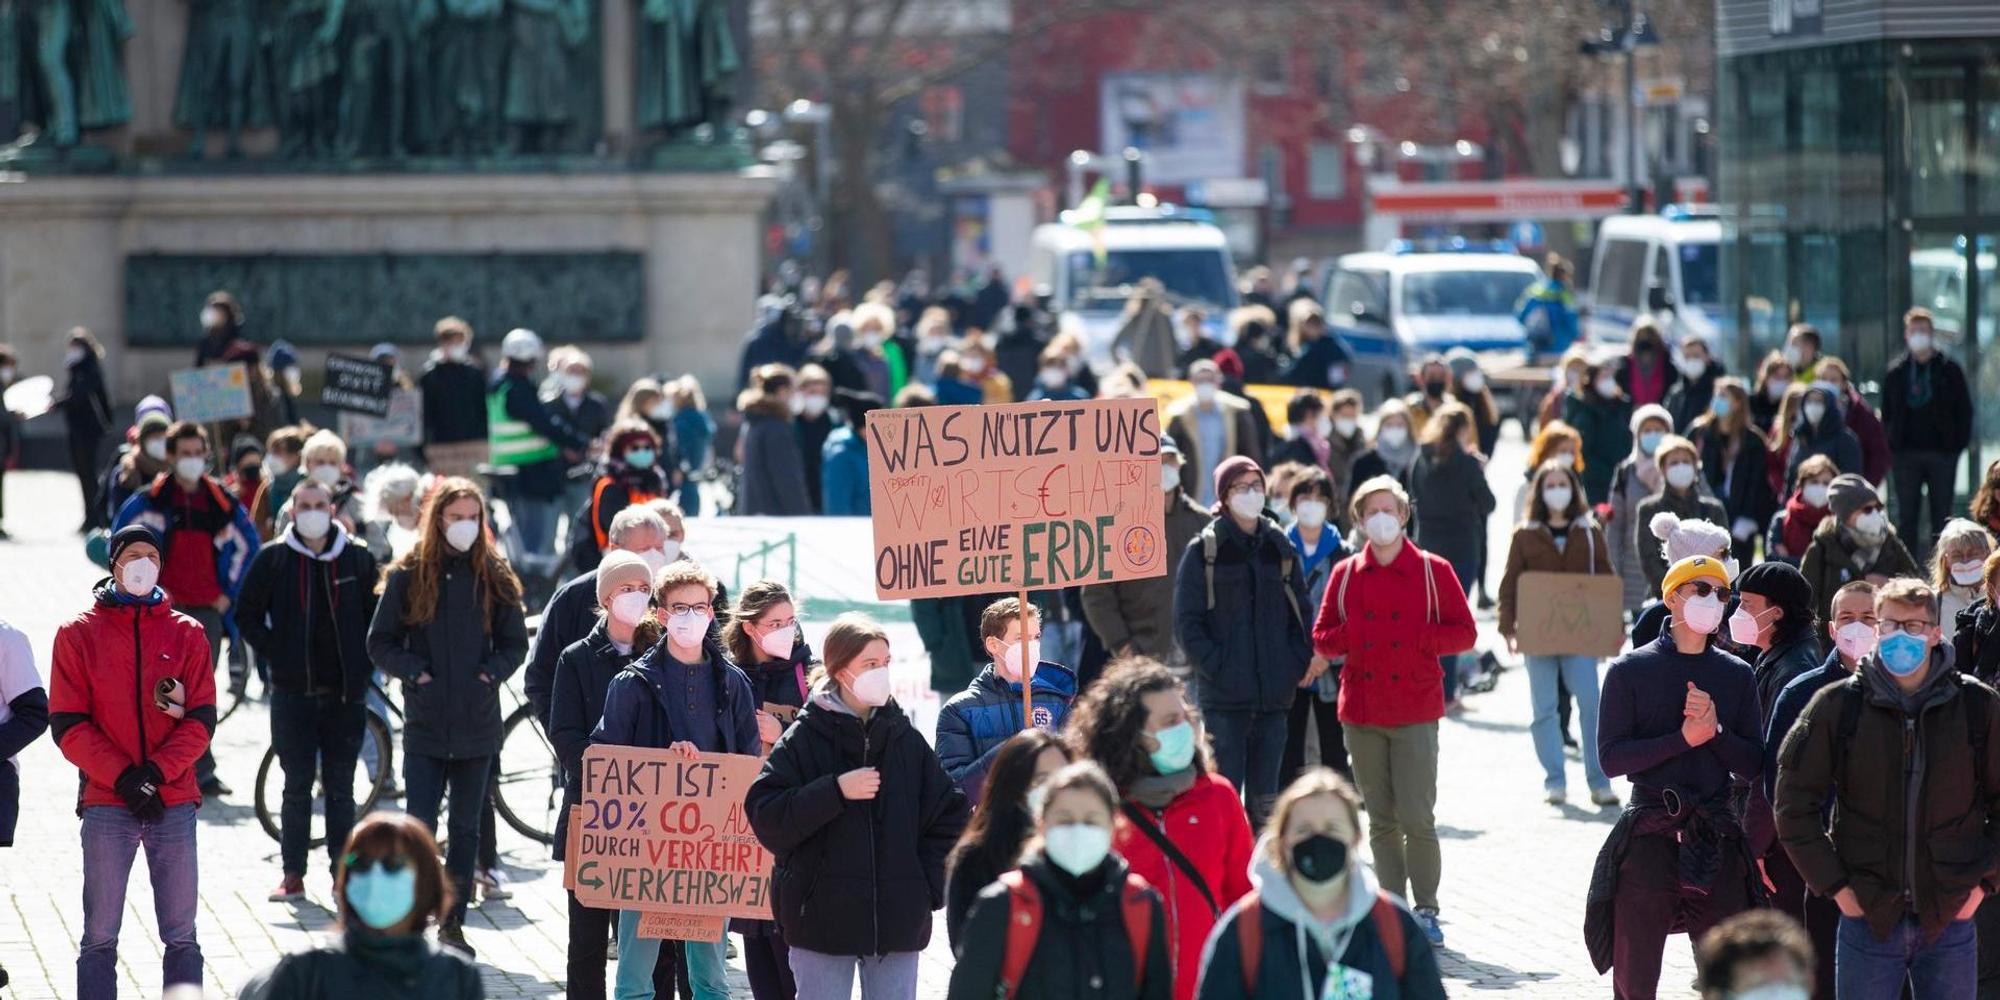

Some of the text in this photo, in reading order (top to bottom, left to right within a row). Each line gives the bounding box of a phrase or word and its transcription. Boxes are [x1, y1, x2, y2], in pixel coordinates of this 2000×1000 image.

[870, 408, 1162, 473] WAS NÜTZT UNS
[876, 515, 1115, 590] OHNE EINE GUTE ERDE
[586, 757, 726, 797] FAKT IST:
[582, 834, 762, 873] DURCH VERKEHR!
